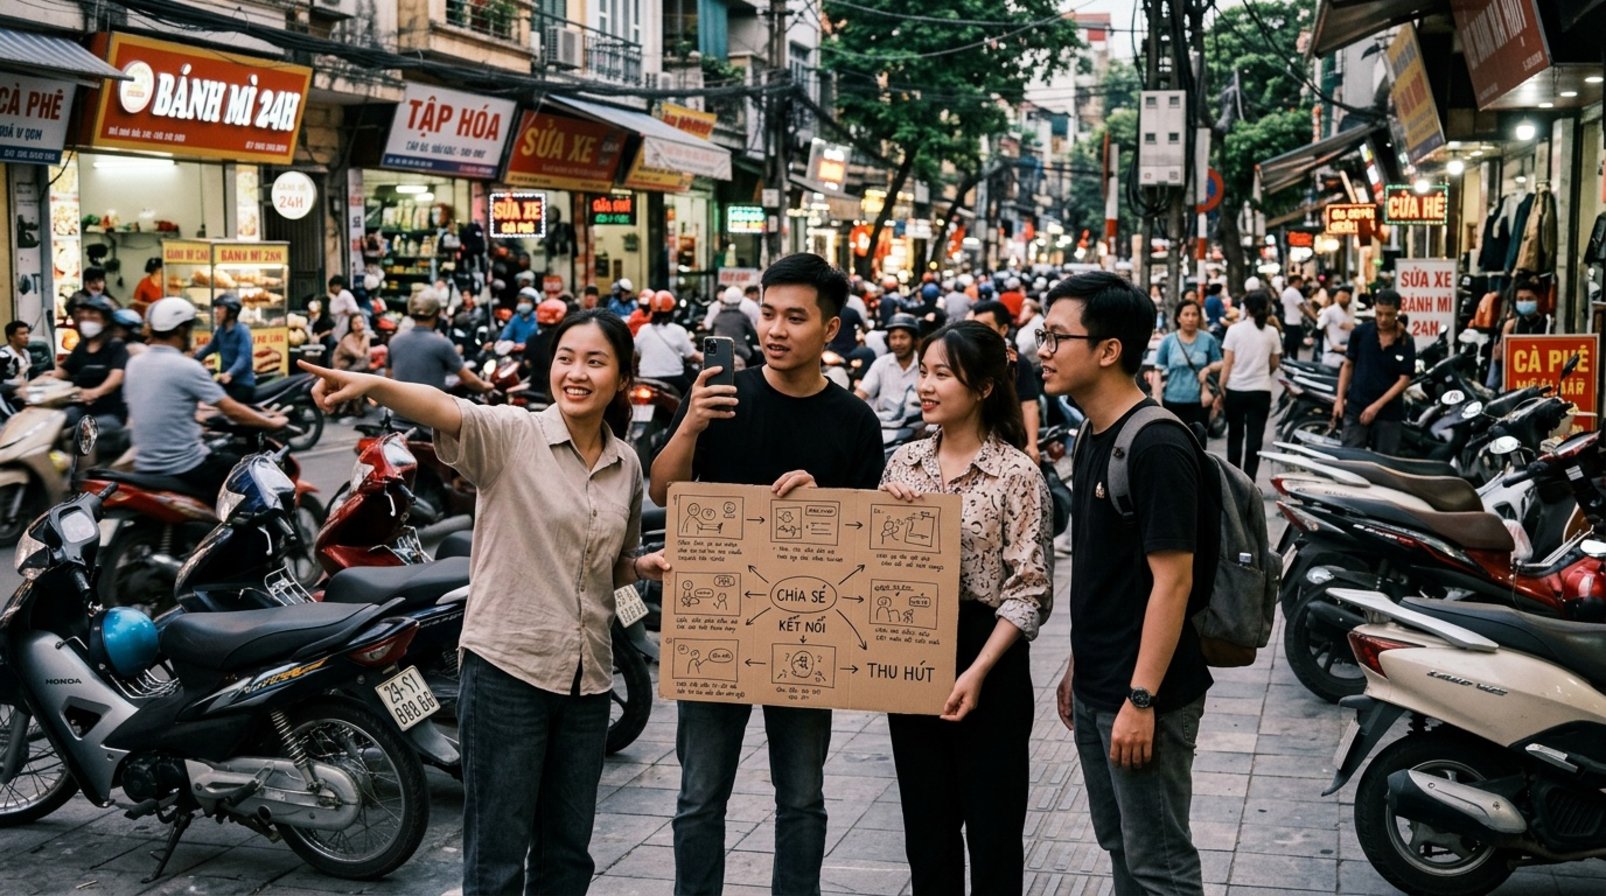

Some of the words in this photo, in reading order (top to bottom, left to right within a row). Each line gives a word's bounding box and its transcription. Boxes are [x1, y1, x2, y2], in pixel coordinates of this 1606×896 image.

[0, 83, 20, 116] CÀ
[152, 63, 227, 123] BÁNH
[223, 74, 258, 127] MÌ
[254, 89, 301, 132] 24H
[408, 95, 453, 137] TẬP
[456, 104, 501, 141] HÓA
[521, 118, 566, 158] SỬA
[567, 133, 597, 163] XE
[279, 195, 304, 208] 24H
[1388, 190, 1419, 218] CỬA
[1401, 266, 1429, 288] SỬA
[1434, 271, 1452, 288] XE
[1437, 293, 1452, 313] MÌ
[1514, 345, 1541, 373] CÀ
[867, 662, 898, 679] THU
[904, 660, 935, 682] HÚT
